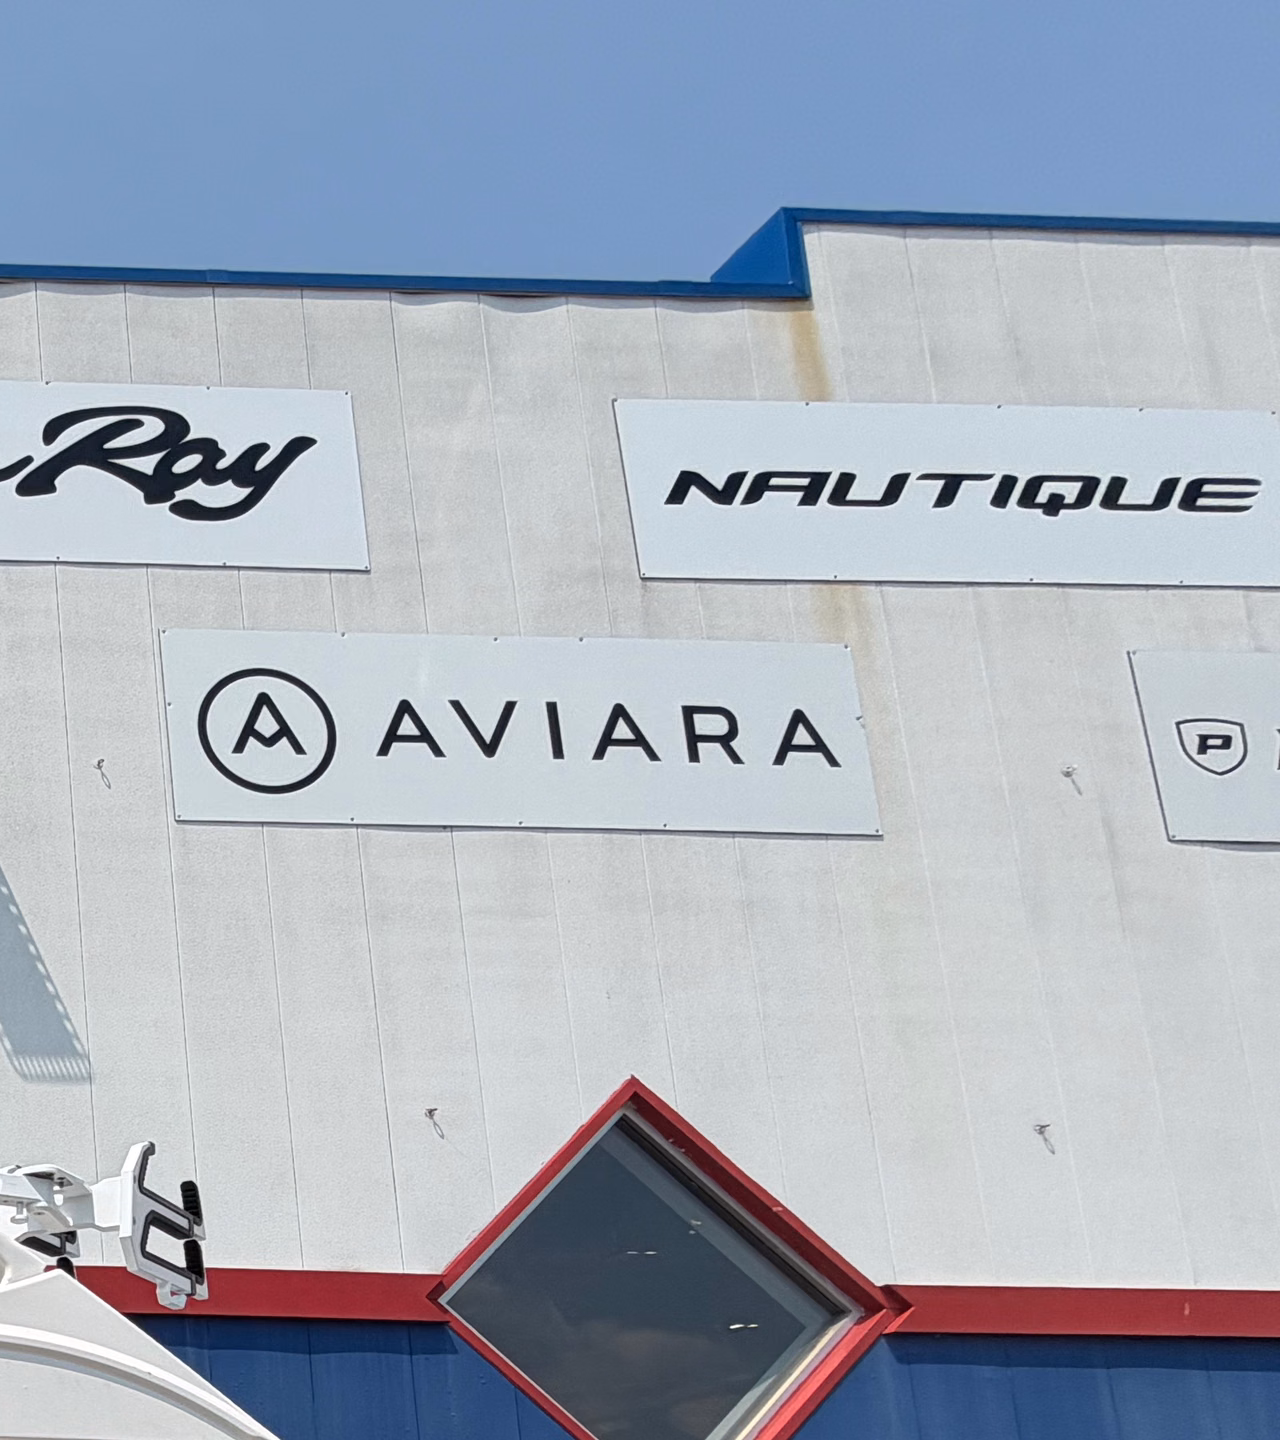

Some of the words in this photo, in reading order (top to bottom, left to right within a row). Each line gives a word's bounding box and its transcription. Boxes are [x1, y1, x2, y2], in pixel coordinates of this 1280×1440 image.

[15, 405, 318, 522] Ray
[664, 470, 1261, 517] NAUTIQUE
[376, 699, 843, 768] AVIARA
